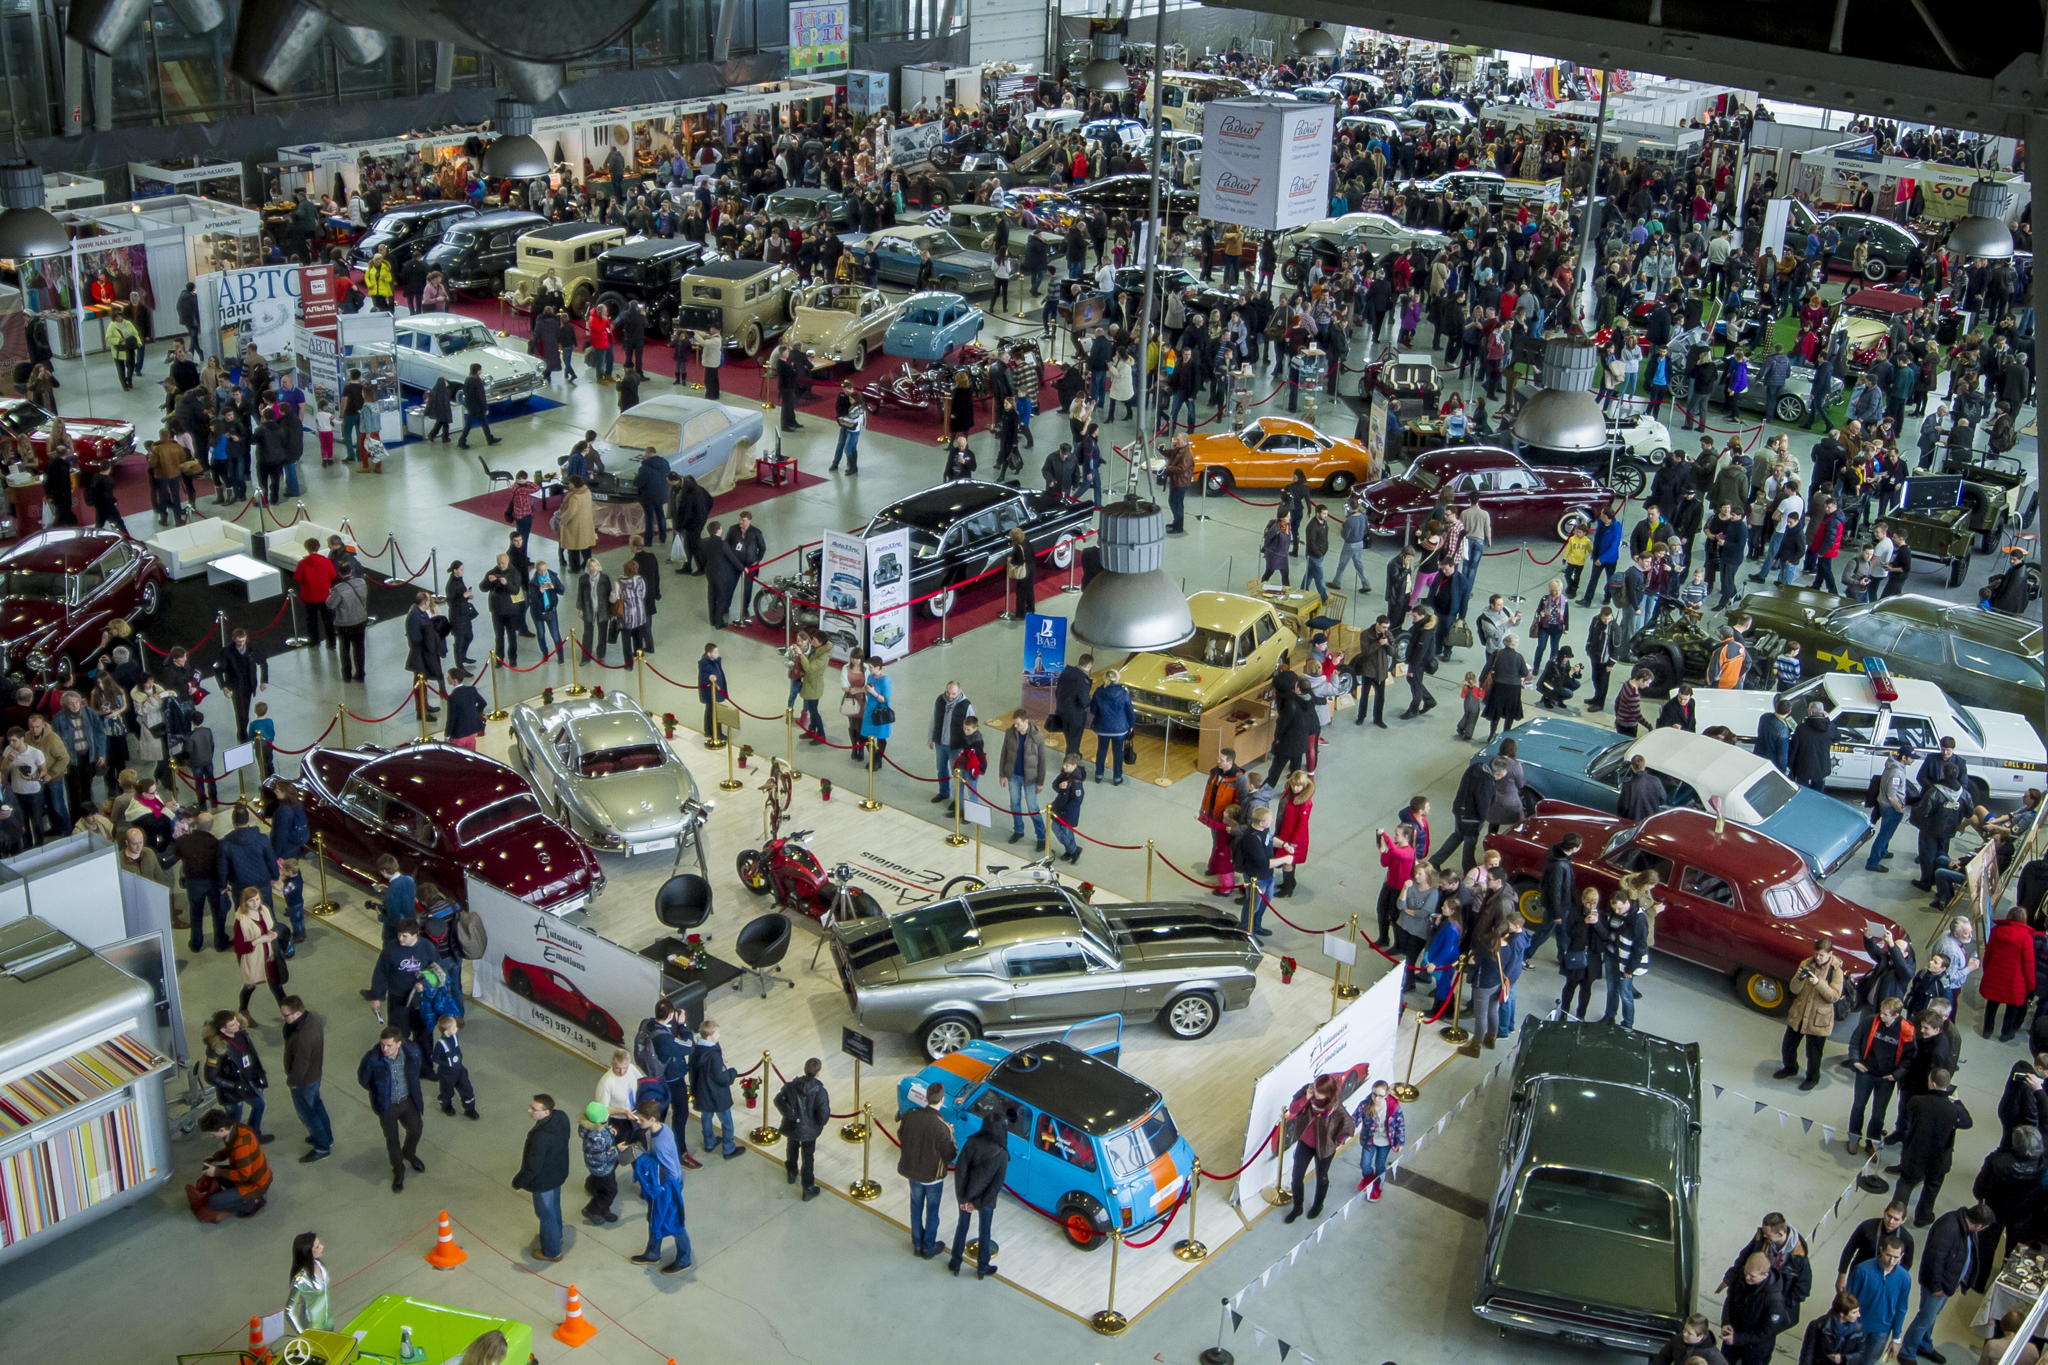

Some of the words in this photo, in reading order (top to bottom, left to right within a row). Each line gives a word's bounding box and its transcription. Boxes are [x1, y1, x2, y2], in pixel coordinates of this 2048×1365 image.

[1220, 115, 1253, 135] Радио
[1294, 119, 1316, 137] Радио
[1217, 172, 1250, 190] Радио
[1289, 176, 1312, 192] Радио
[218, 268, 302, 307] АВТО
[2003, 760, 2020, 768] CALL
[2022, 762, 2036, 770] 911
[860, 851, 945, 884] Emotions
[534, 916, 583, 951] Automotiv
[544, 945, 586, 972] Emotions
[531, 1007, 553, 1030] (495)
